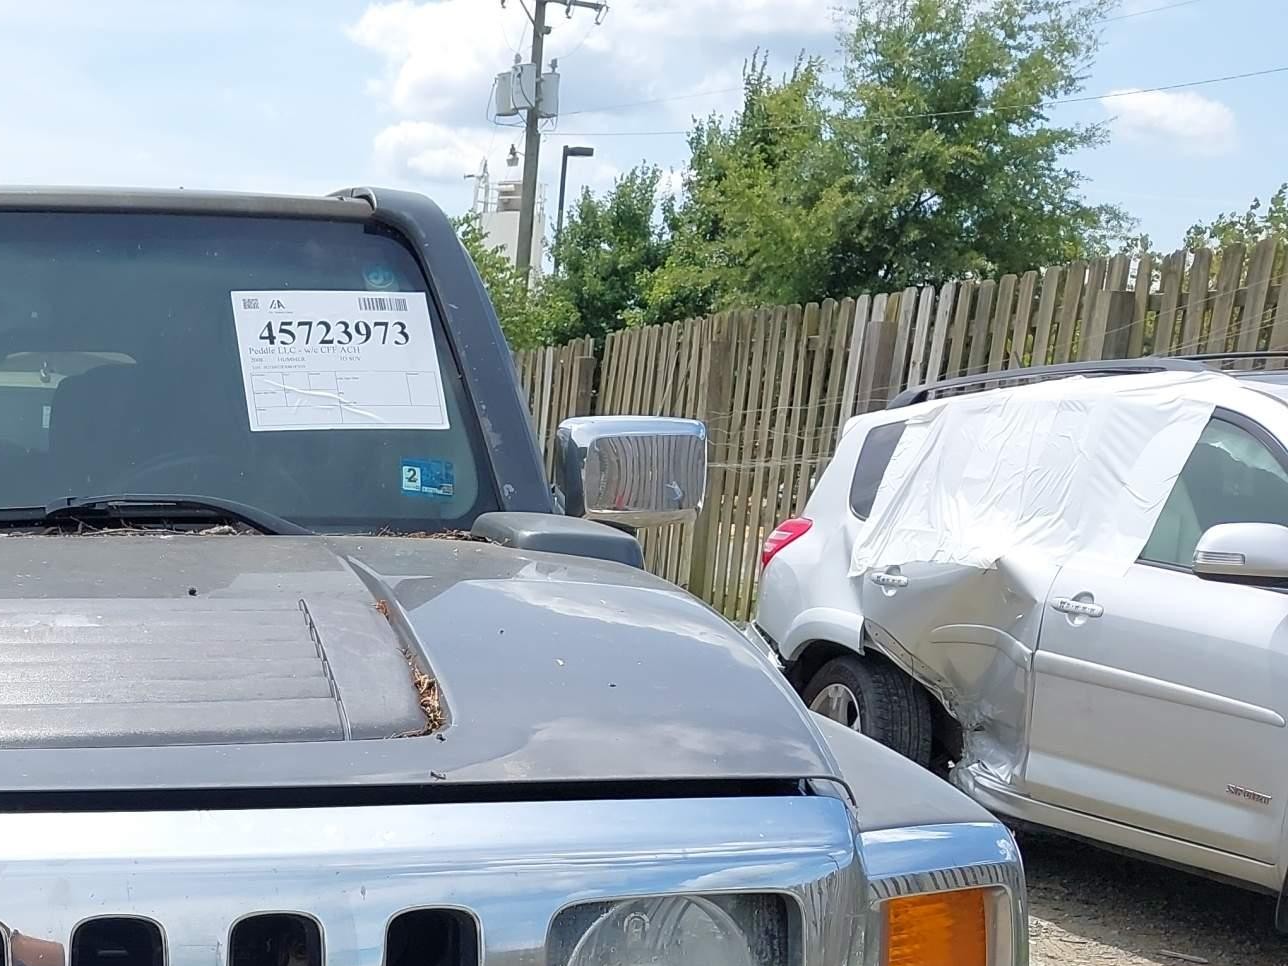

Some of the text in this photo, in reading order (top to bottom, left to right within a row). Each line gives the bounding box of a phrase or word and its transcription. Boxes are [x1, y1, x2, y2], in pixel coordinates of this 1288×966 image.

[259, 320, 409, 345] 45723973
[249, 346, 275, 354] Peddle
[278, 346, 296, 354] LLC
[407, 468, 417, 482] 2
